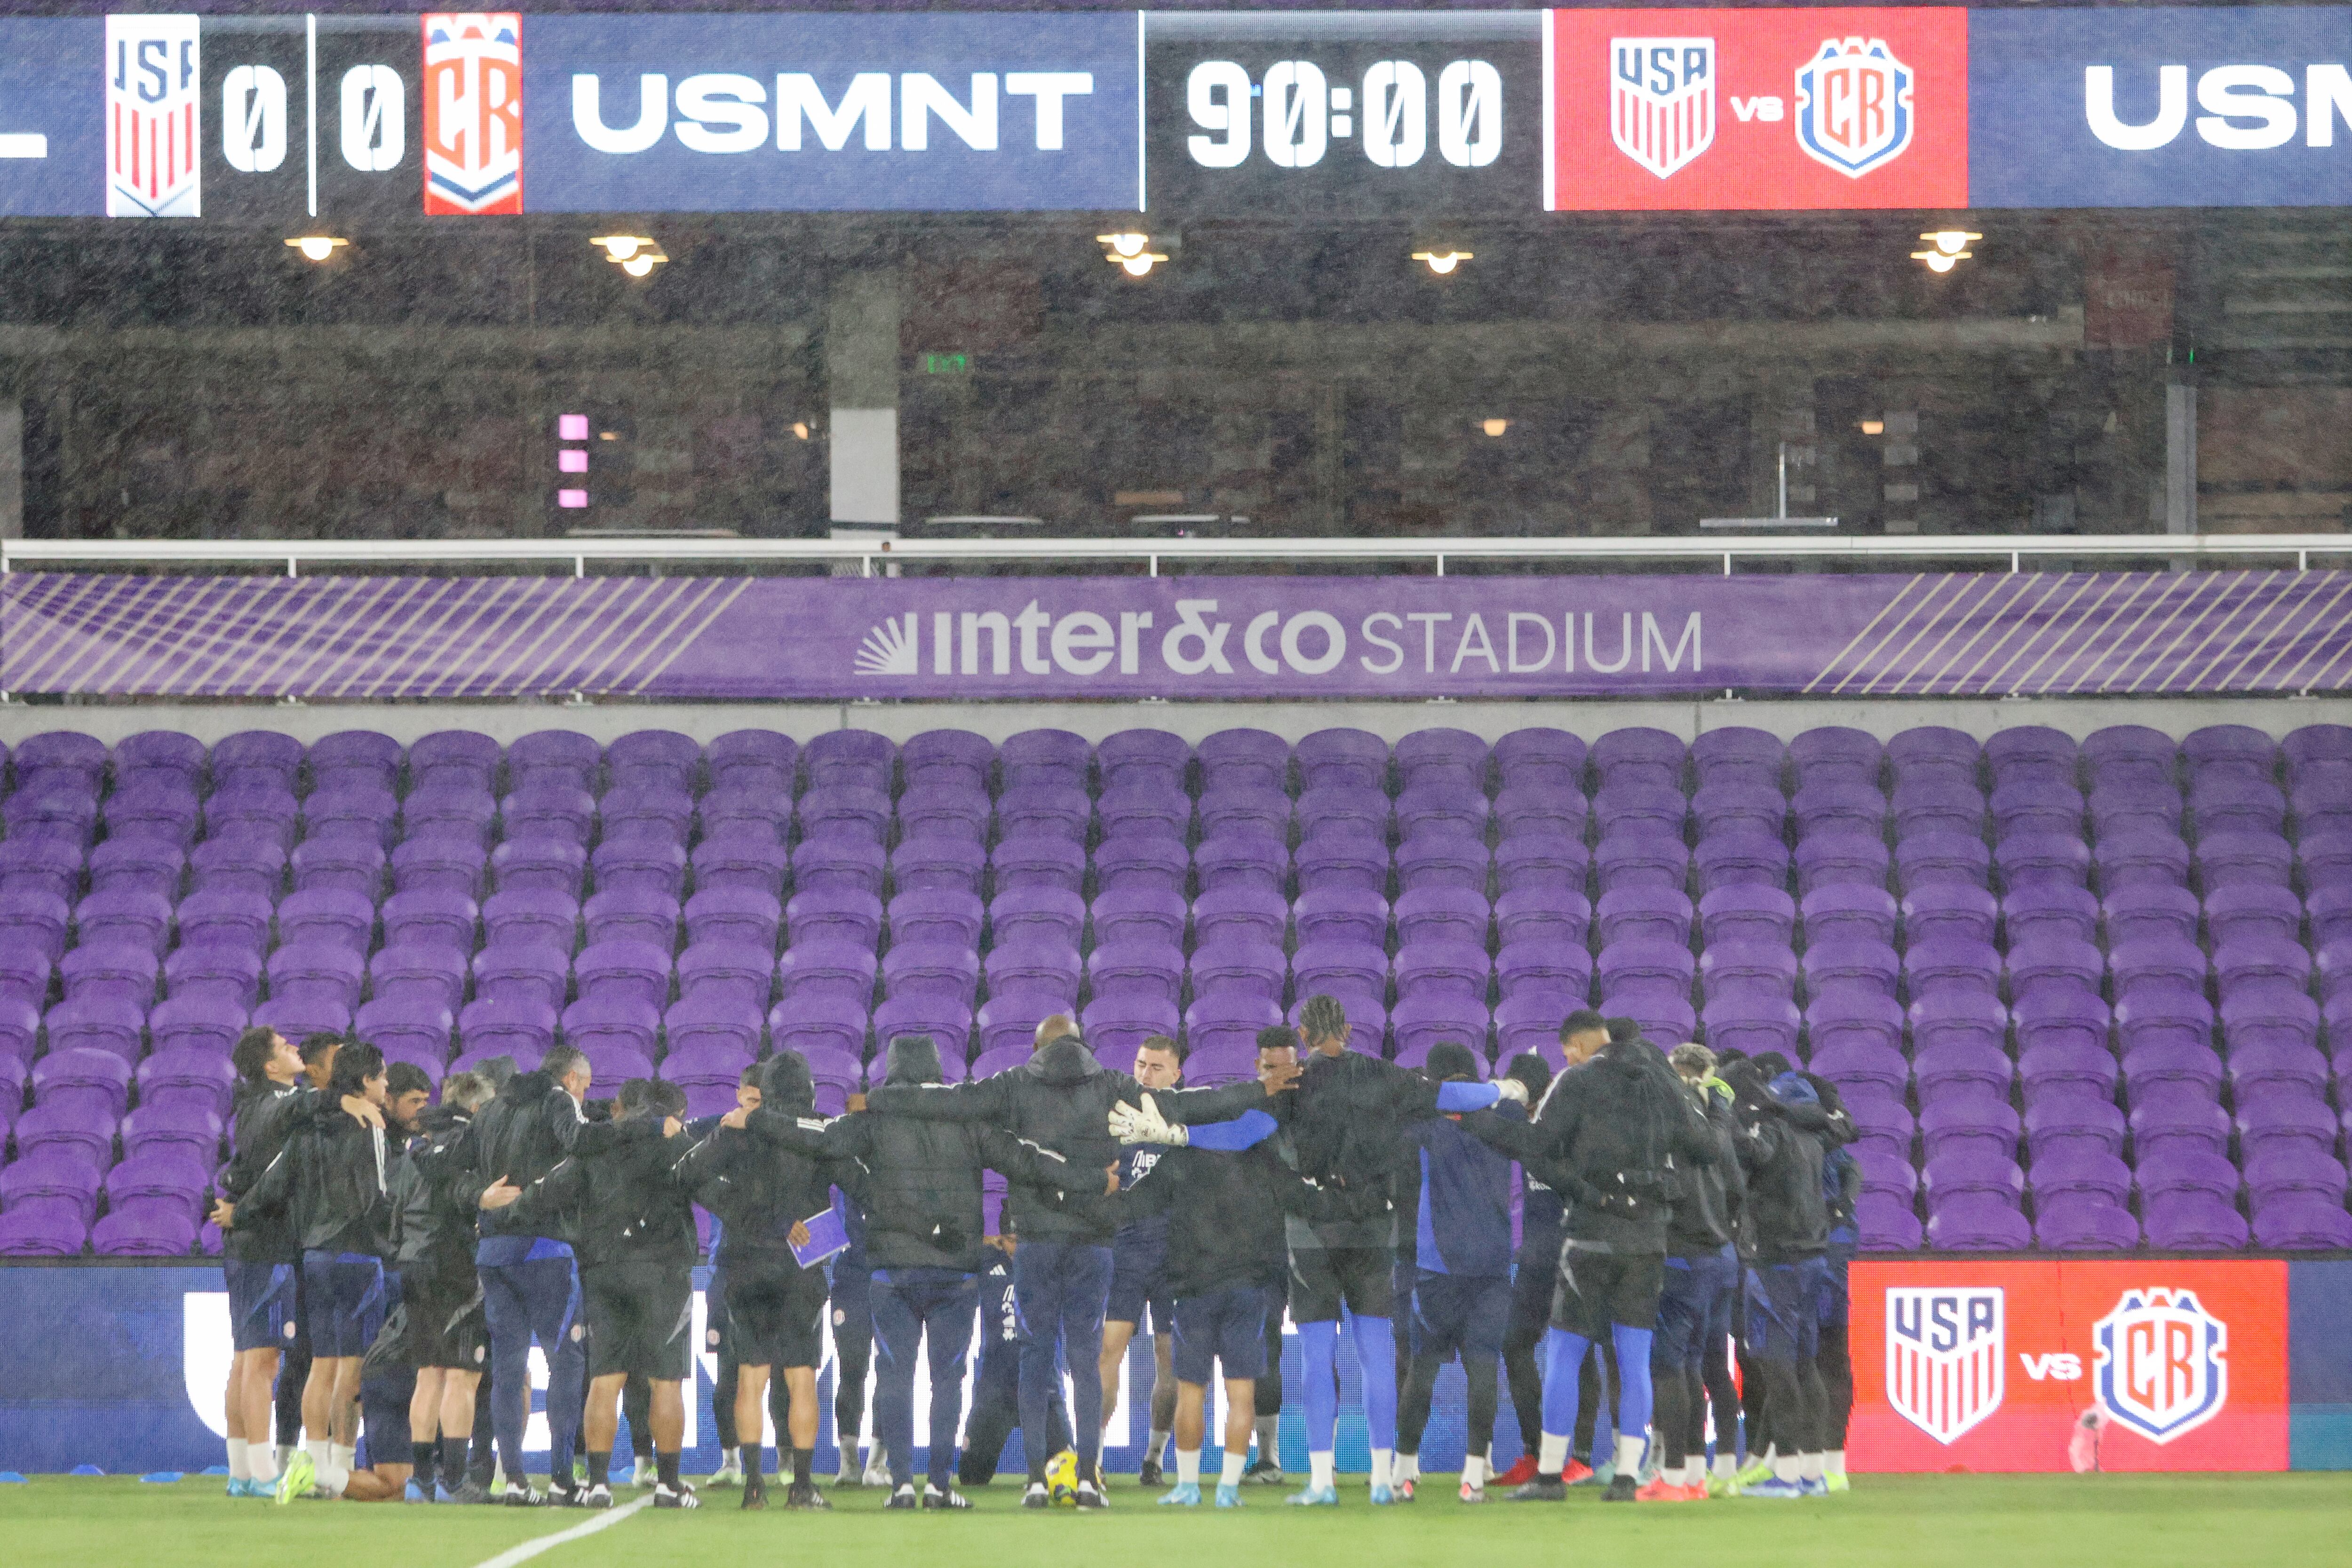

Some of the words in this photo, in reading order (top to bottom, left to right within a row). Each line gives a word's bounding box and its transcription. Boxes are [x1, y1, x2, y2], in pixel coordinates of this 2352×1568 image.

[223, 65, 287, 172] 0
[341, 64, 405, 171] 0
[572, 73, 1093, 154] USMNT
[1187, 60, 1502, 168] 90:00
[1619, 48, 1707, 96] USA
[1824, 68, 1885, 148] CR
[1359, 611, 1701, 675] STADIUM
[1895, 1297, 1994, 1353] USA
[2127, 1320, 2193, 1411] CR
